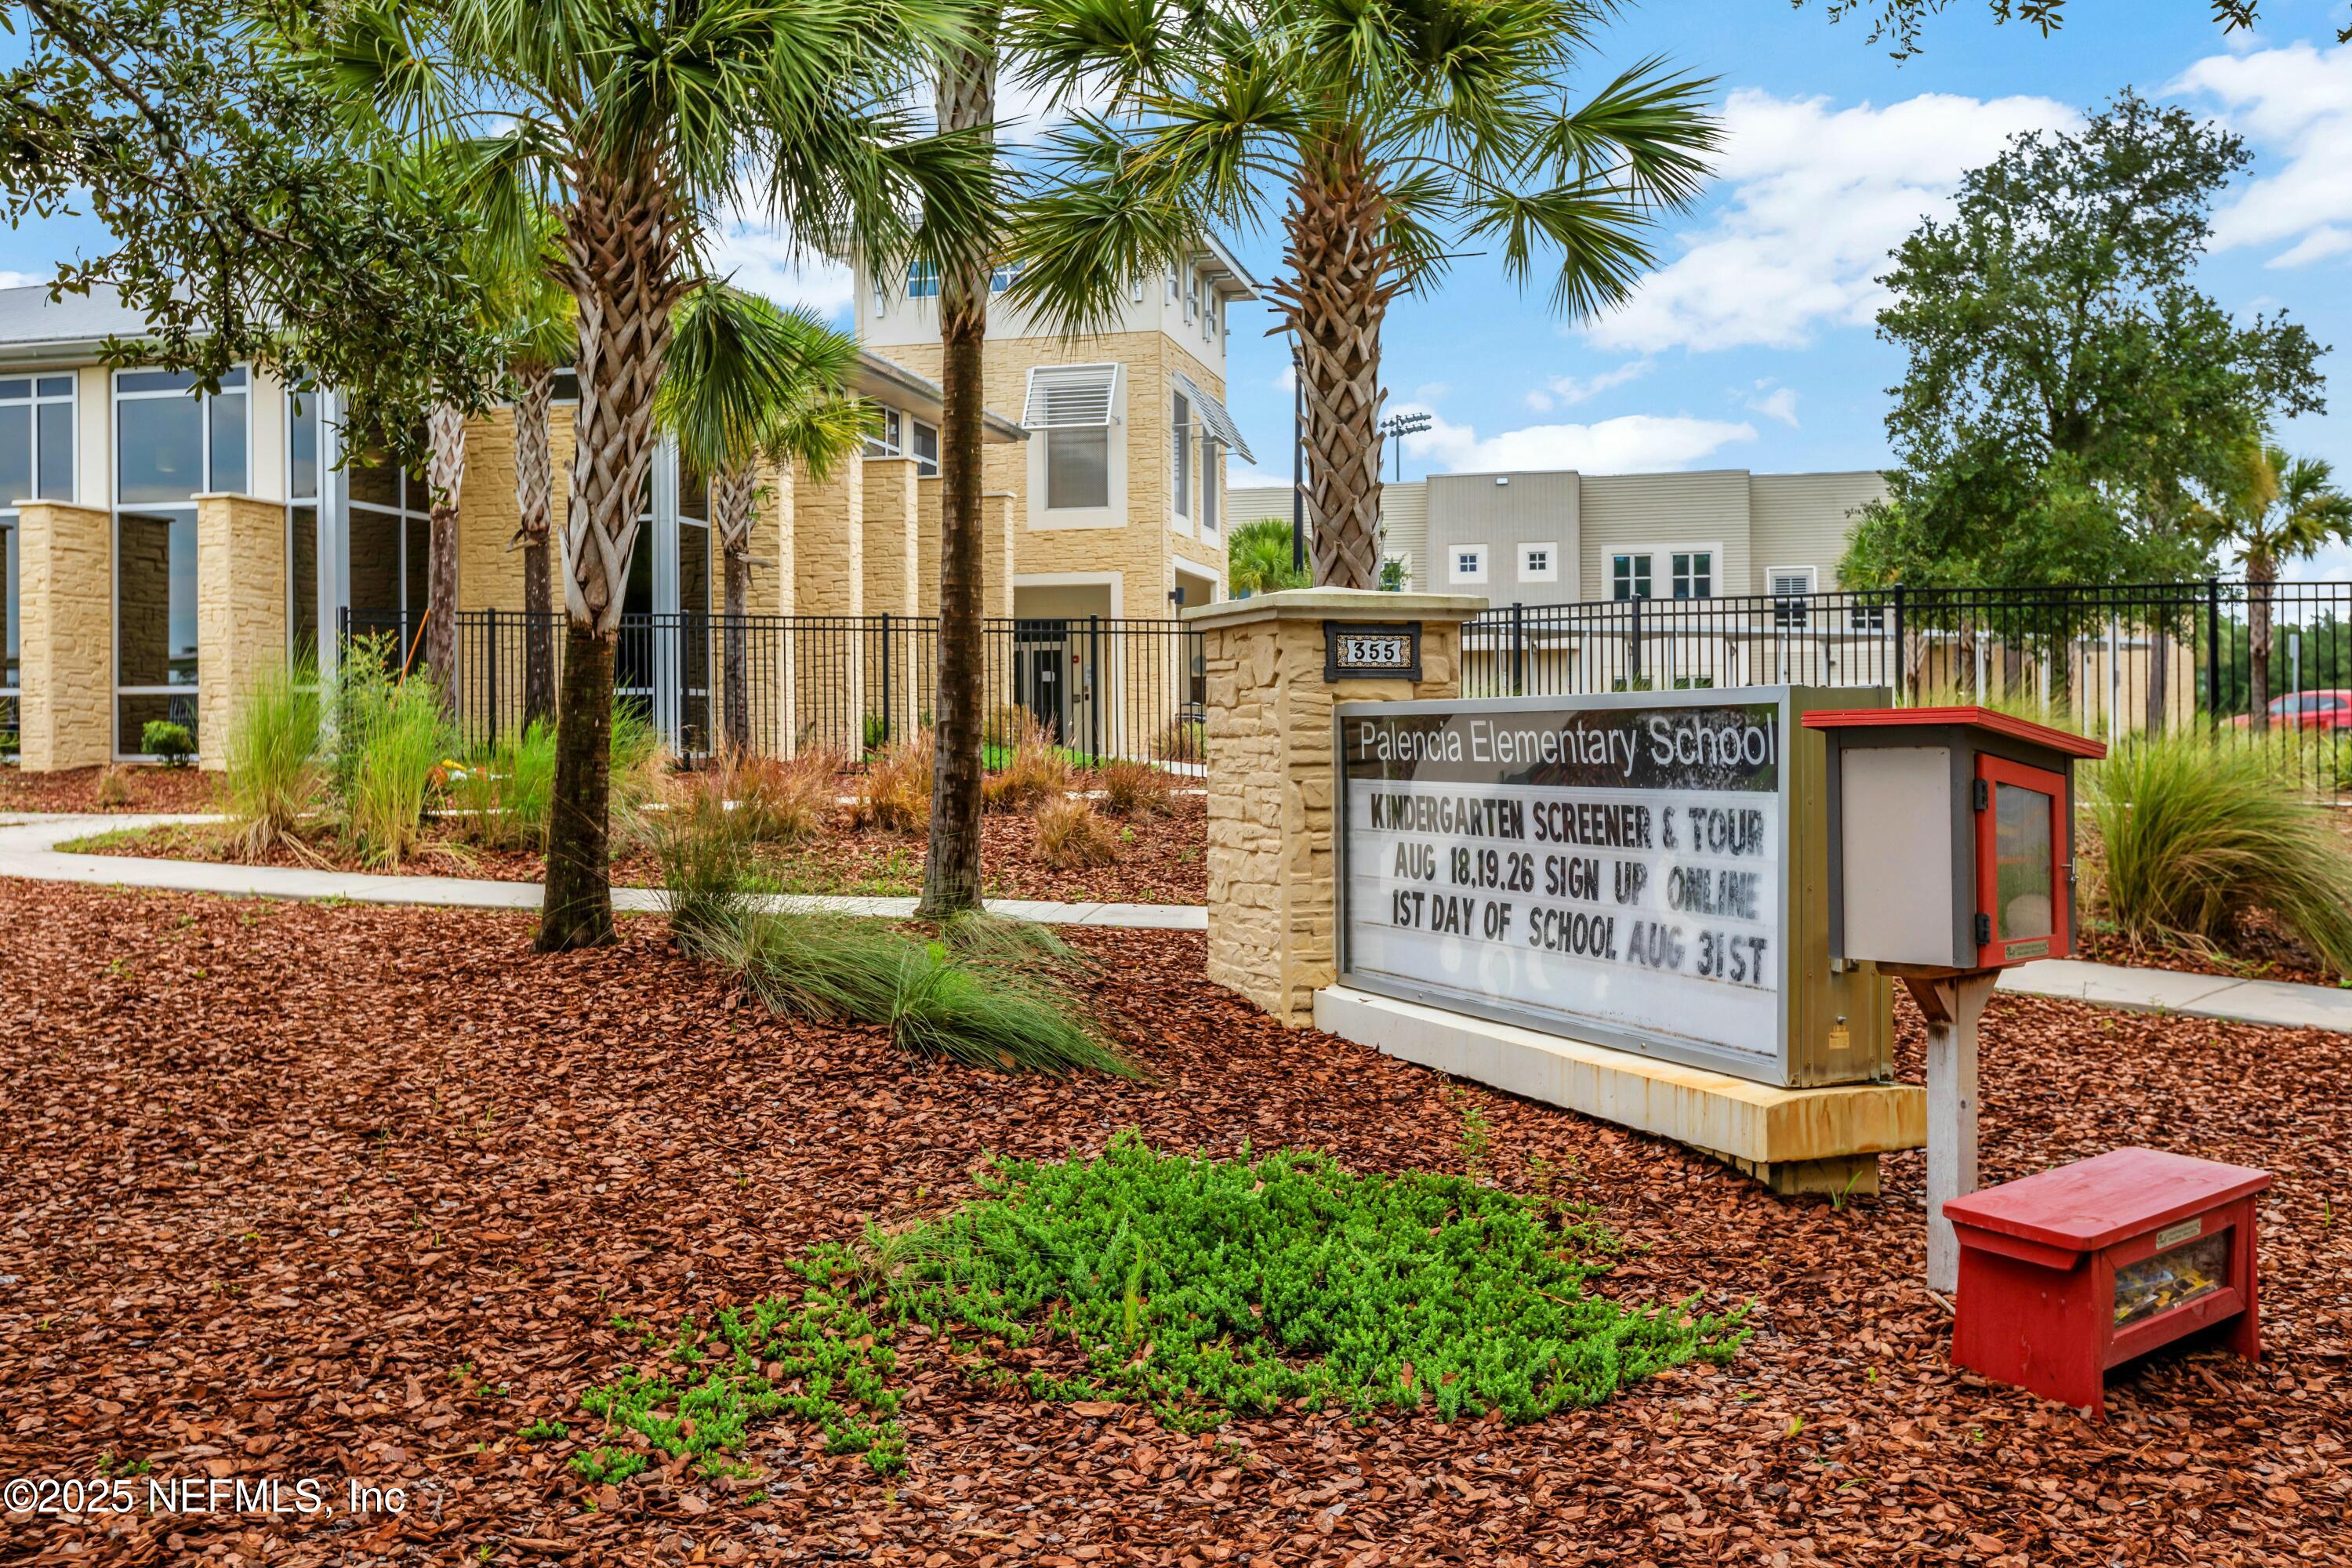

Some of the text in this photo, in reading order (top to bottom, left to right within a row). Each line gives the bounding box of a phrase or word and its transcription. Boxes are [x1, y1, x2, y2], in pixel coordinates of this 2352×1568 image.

[1354, 642, 1394, 660] 355
[1360, 713, 1776, 778] Palencia Elementary School
[1370, 793, 1765, 857] KINDERGARTEN SCREENER & TOUR
[1393, 841, 1436, 881] AUG
[1545, 855, 1599, 902] SIGN
[1614, 860, 1648, 906] UP
[1667, 865, 1762, 920] ONLINE
[1392, 888, 1768, 985] 1ST DAY OF SCHOOL AUG 31ST
